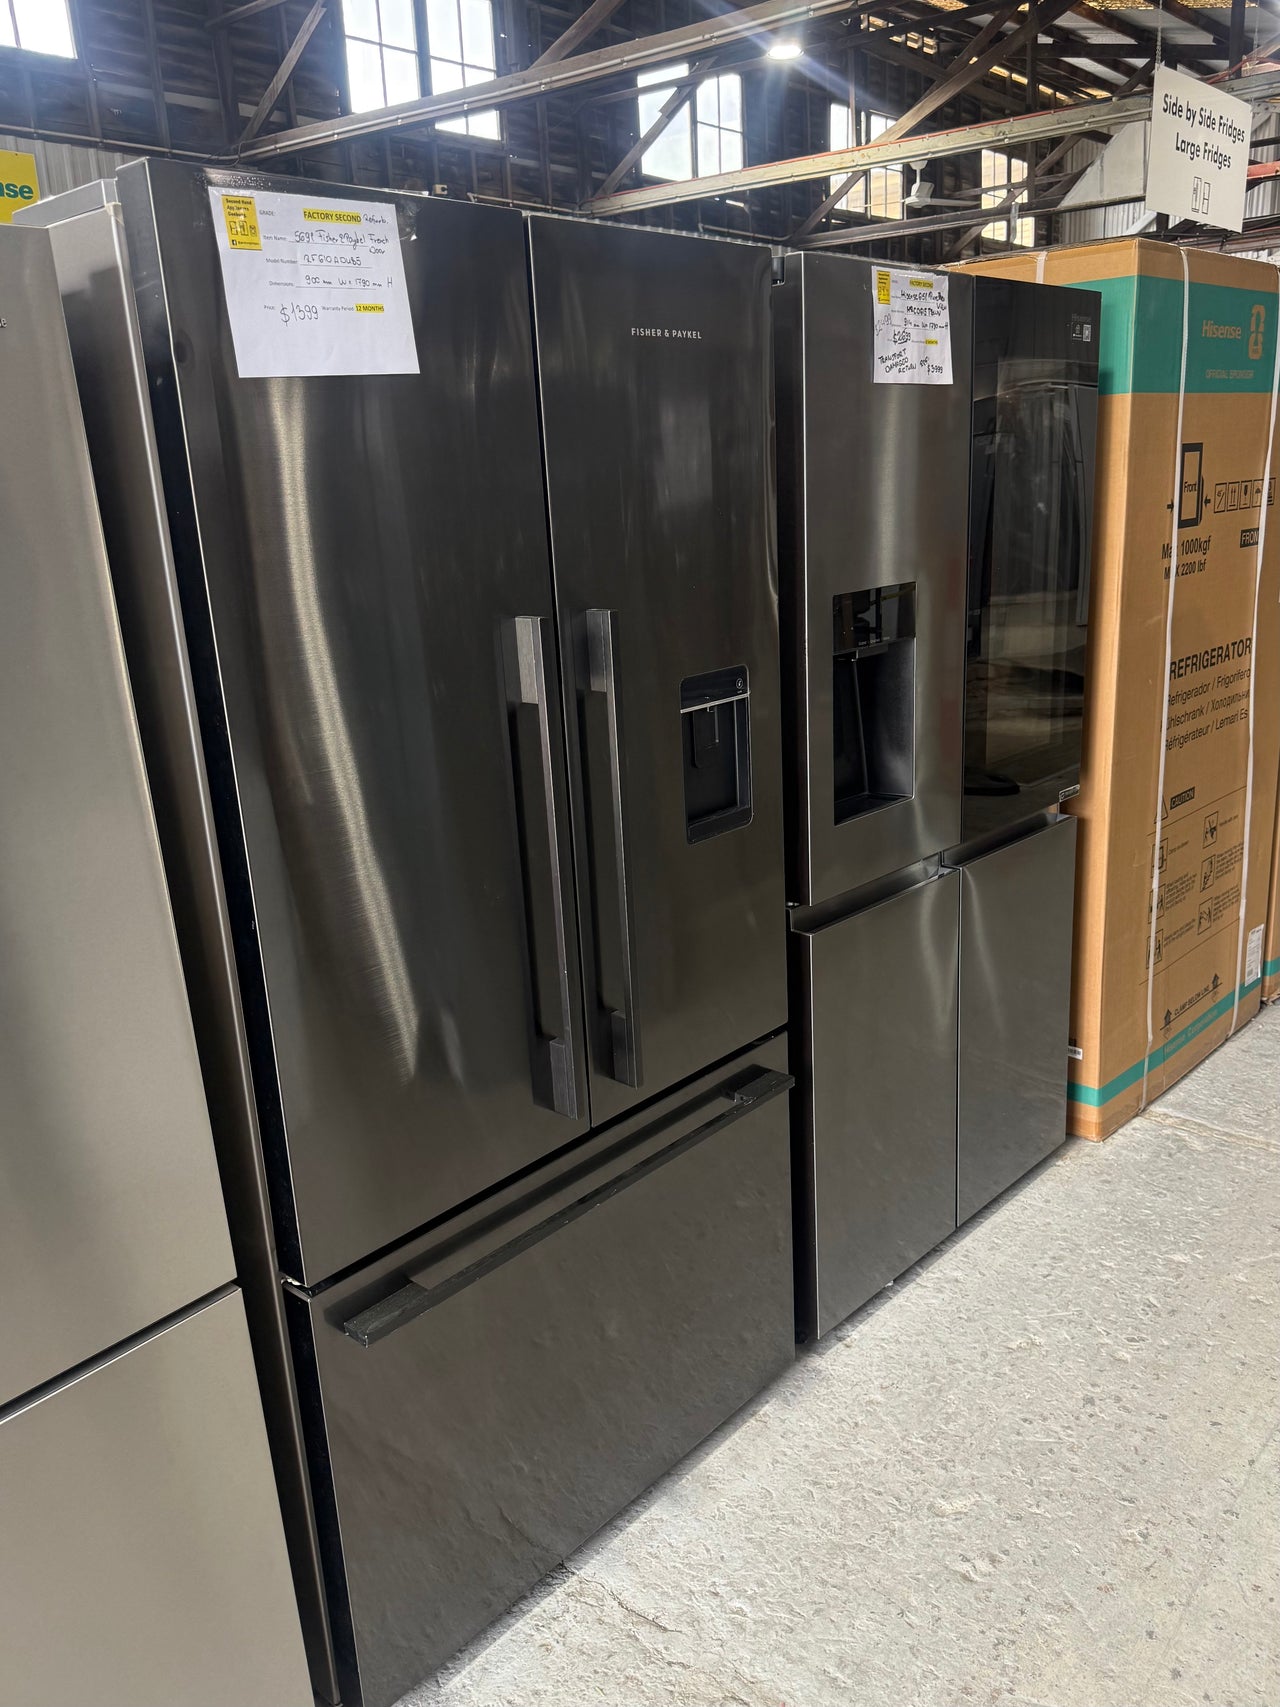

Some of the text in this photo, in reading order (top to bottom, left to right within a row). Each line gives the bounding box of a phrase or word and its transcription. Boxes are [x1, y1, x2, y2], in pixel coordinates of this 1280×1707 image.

[1163, 93, 1245, 144] Side by Side Fridges
[1175, 132, 1231, 170] Large Fridges
[0, 182, 34, 200] se
[304, 211, 334, 221] FACTORY
[335, 213, 362, 223] SECOND
[387, 276, 393, 288] H
[279, 302, 319, 327] $1399
[631, 327, 702, 339] FISHER & PAYKEL
[1202, 319, 1242, 339] Hisense
[1184, 482, 1197, 493] Front
[1162, 535, 1212, 560] Ma 1000kgf
[1241, 531, 1259, 545] FRON
[1164, 564, 1180, 580] MX
[1180, 561, 1197, 577] 2200
[1170, 638, 1252, 681] REFRIGERATOR
[1211, 690, 1250, 713] Холодильни
[1171, 789, 1194, 808] CAUTION
